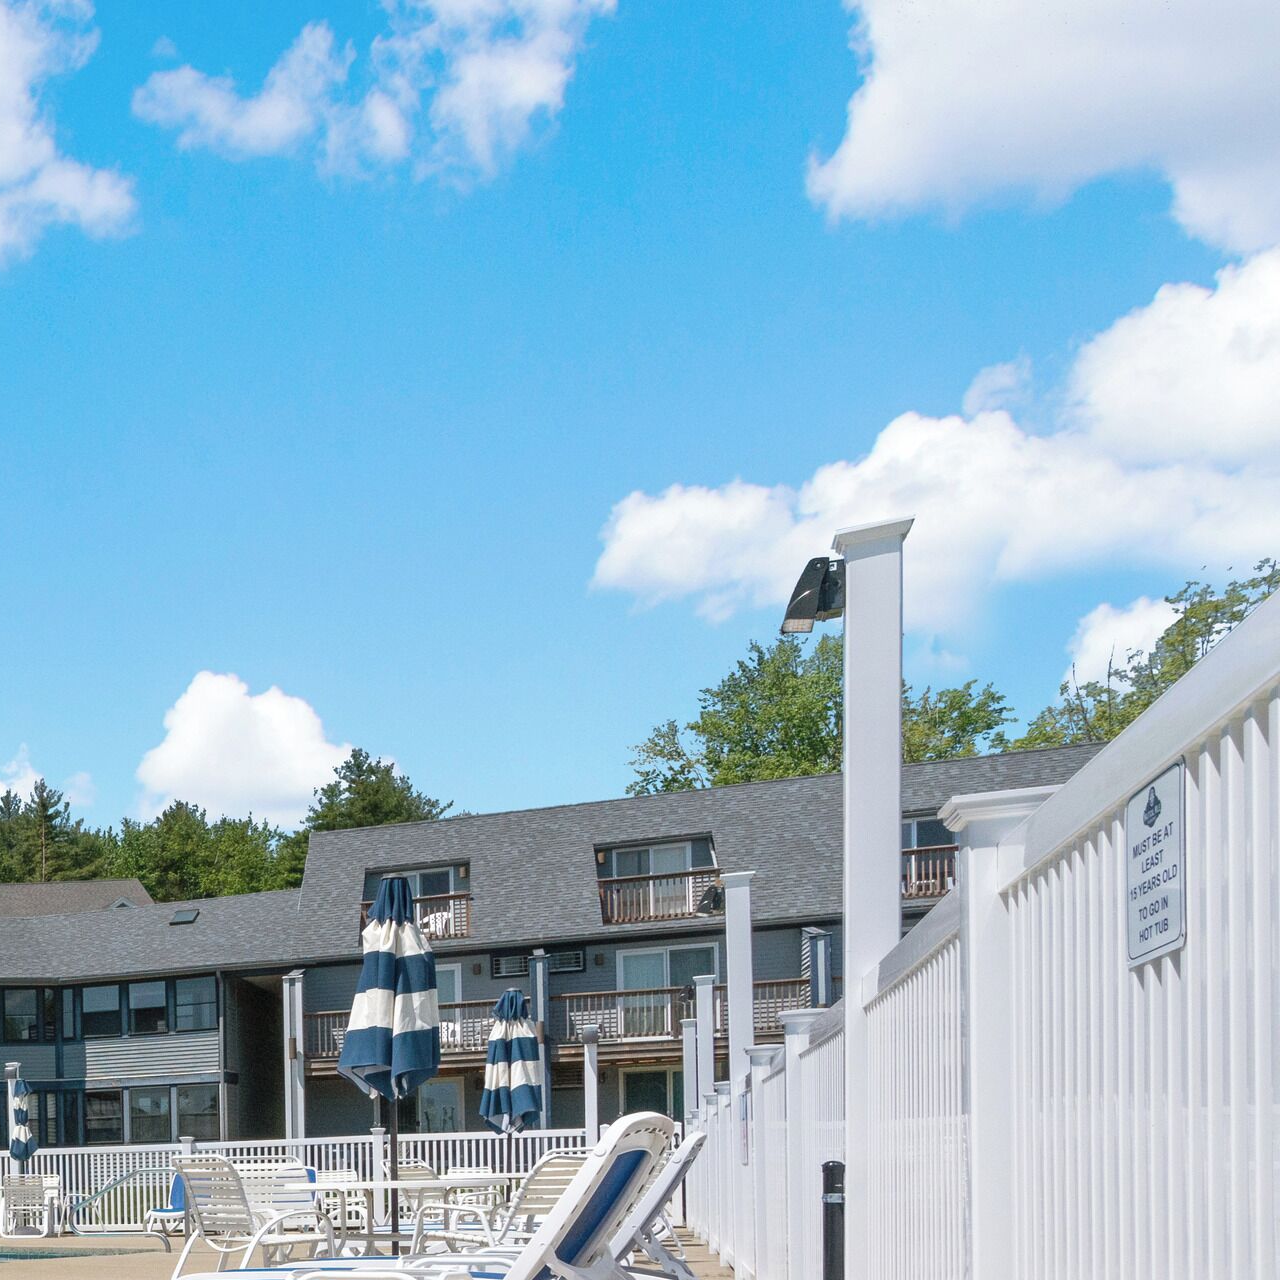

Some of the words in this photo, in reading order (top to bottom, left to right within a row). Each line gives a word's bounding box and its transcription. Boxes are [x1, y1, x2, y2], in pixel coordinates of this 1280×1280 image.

[1132, 836, 1151, 859] MUST
[1152, 829, 1163, 847] BE
[1163, 821, 1174, 842] AT
[1141, 849, 1164, 874] LEAST
[1130, 887, 1138, 902] 15
[1138, 875, 1161, 896] YEARS
[1162, 864, 1178, 882] OLD
[1139, 906, 1148, 921] TO
[1148, 901, 1160, 917] GO
[1160, 895, 1169, 911] IN
[1139, 925, 1153, 943] HOT
[1154, 917, 1169, 935] TUB
